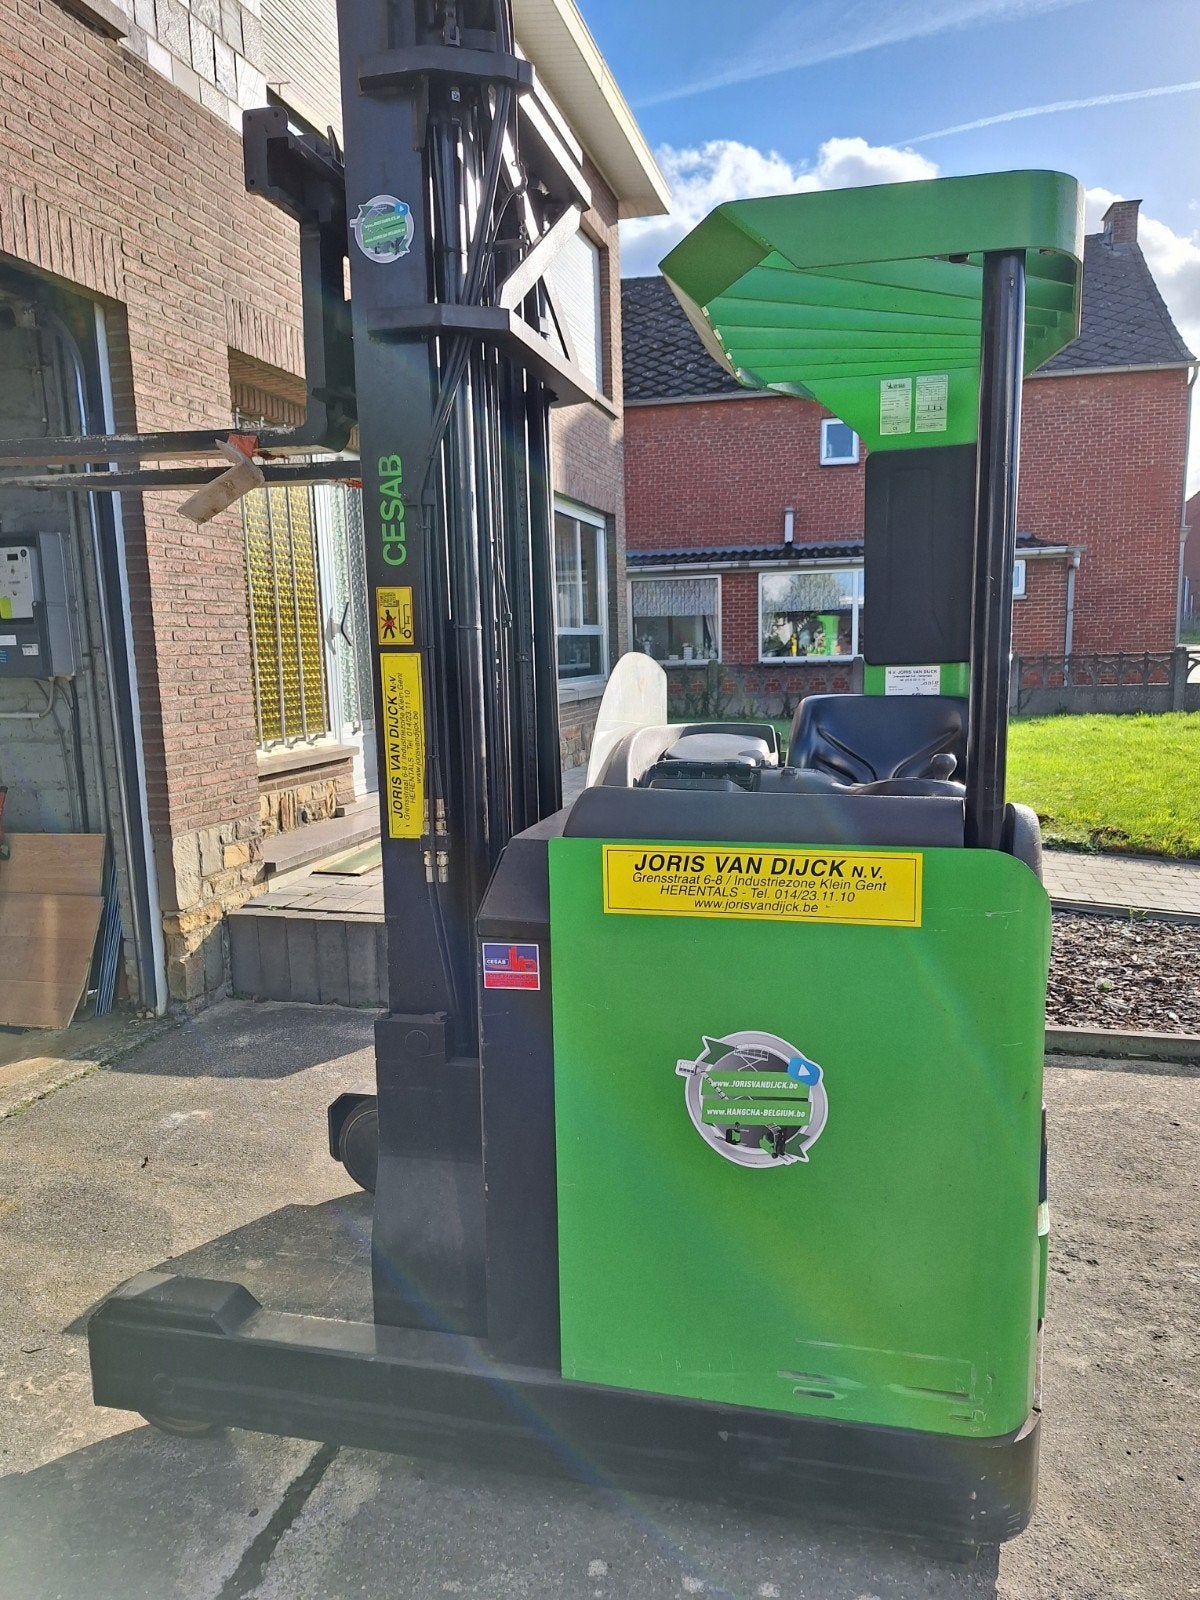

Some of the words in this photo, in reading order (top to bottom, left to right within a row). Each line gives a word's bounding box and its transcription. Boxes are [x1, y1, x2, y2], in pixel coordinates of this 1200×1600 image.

[378, 453, 407, 566] CESAB
[387, 695, 400, 738] DIJCK
[390, 743, 400, 770] VAN
[408, 757, 416, 804] HERENTALS
[392, 776, 403, 818] JORIS
[634, 854, 706, 872] JORIS
[716, 856, 762, 874] VAN
[771, 858, 846, 878] DIJCK
[852, 866, 883, 878] N.V.
[632, 872, 700, 885] Grensstraat
[704, 875, 722, 885] 6-8
[726, 876, 732, 886] /
[734, 876, 816, 888] Industriezone
[820, 878, 850, 890] Klein
[856, 880, 886, 892] Gent
[660, 885, 738, 898] HERENTALS
[750, 888, 770, 899] Tel.
[774, 888, 856, 902] 014/23.11.10
[694, 898, 818, 913] www.jorisvandijck.be
